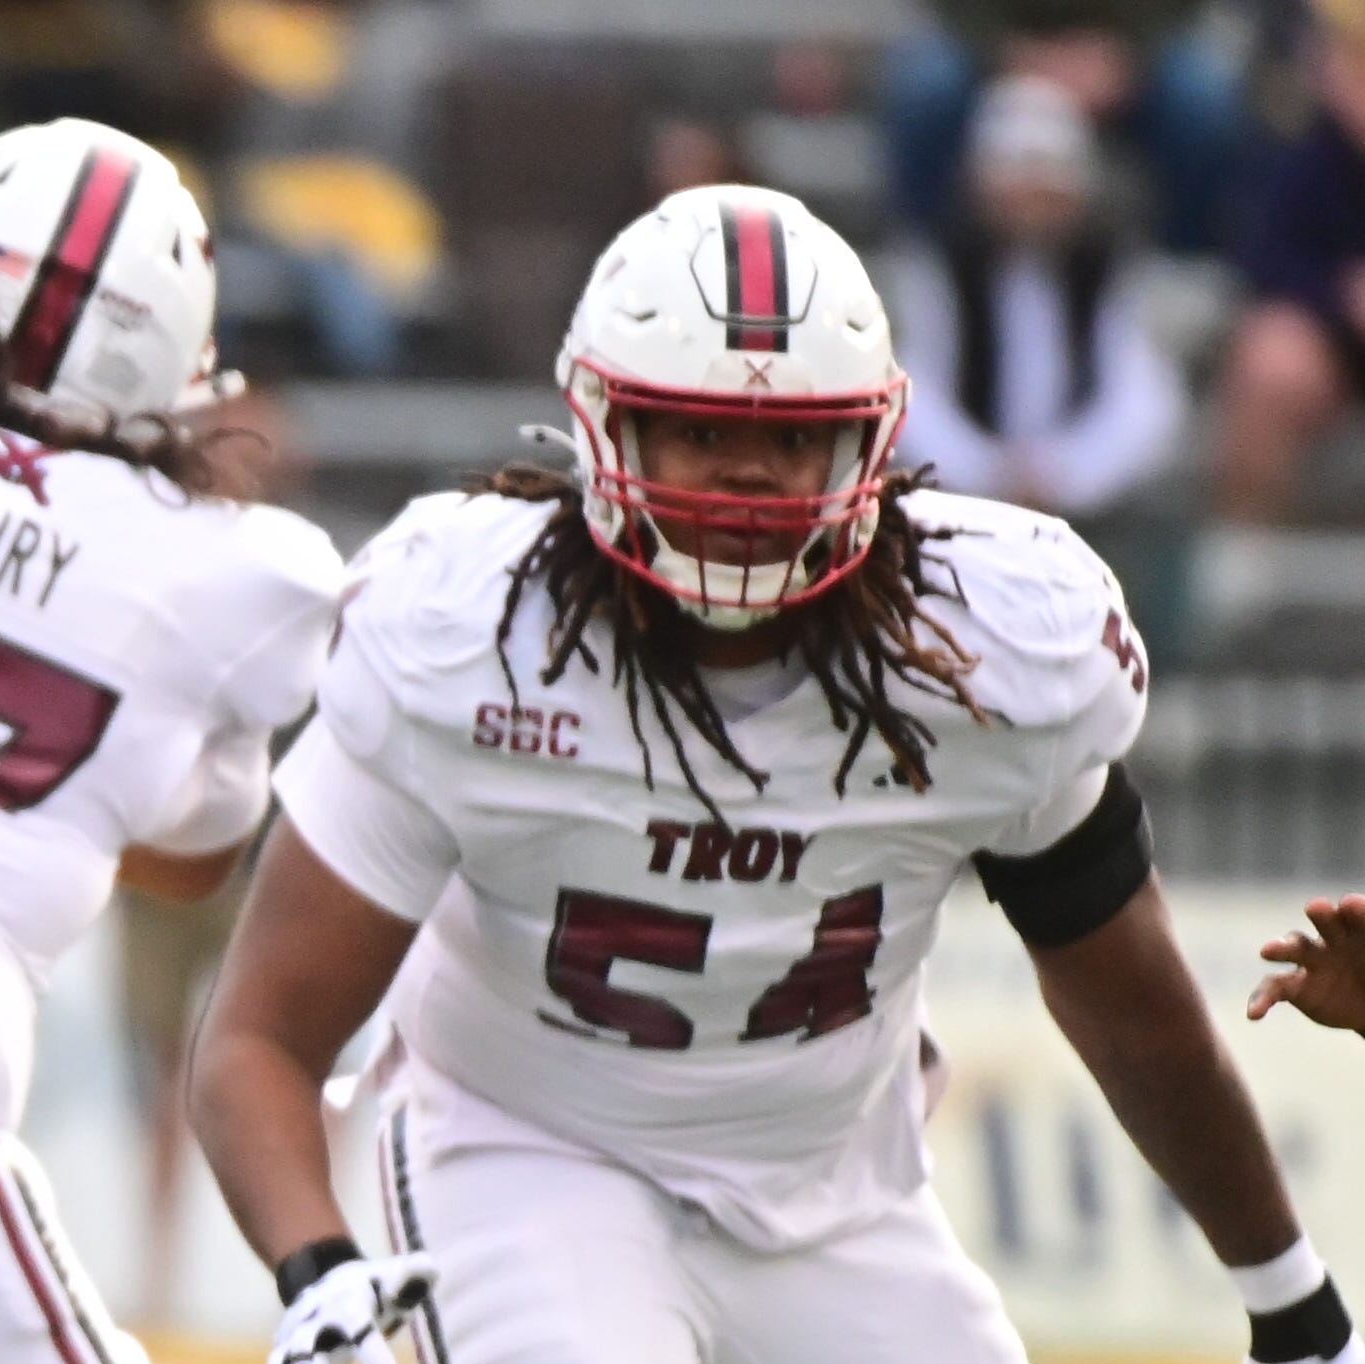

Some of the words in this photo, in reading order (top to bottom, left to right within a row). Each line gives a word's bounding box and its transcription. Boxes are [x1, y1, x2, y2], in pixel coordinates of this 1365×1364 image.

[472, 701, 582, 760] SBC
[645, 817, 818, 883] TROY
[536, 882, 884, 1051] 54
